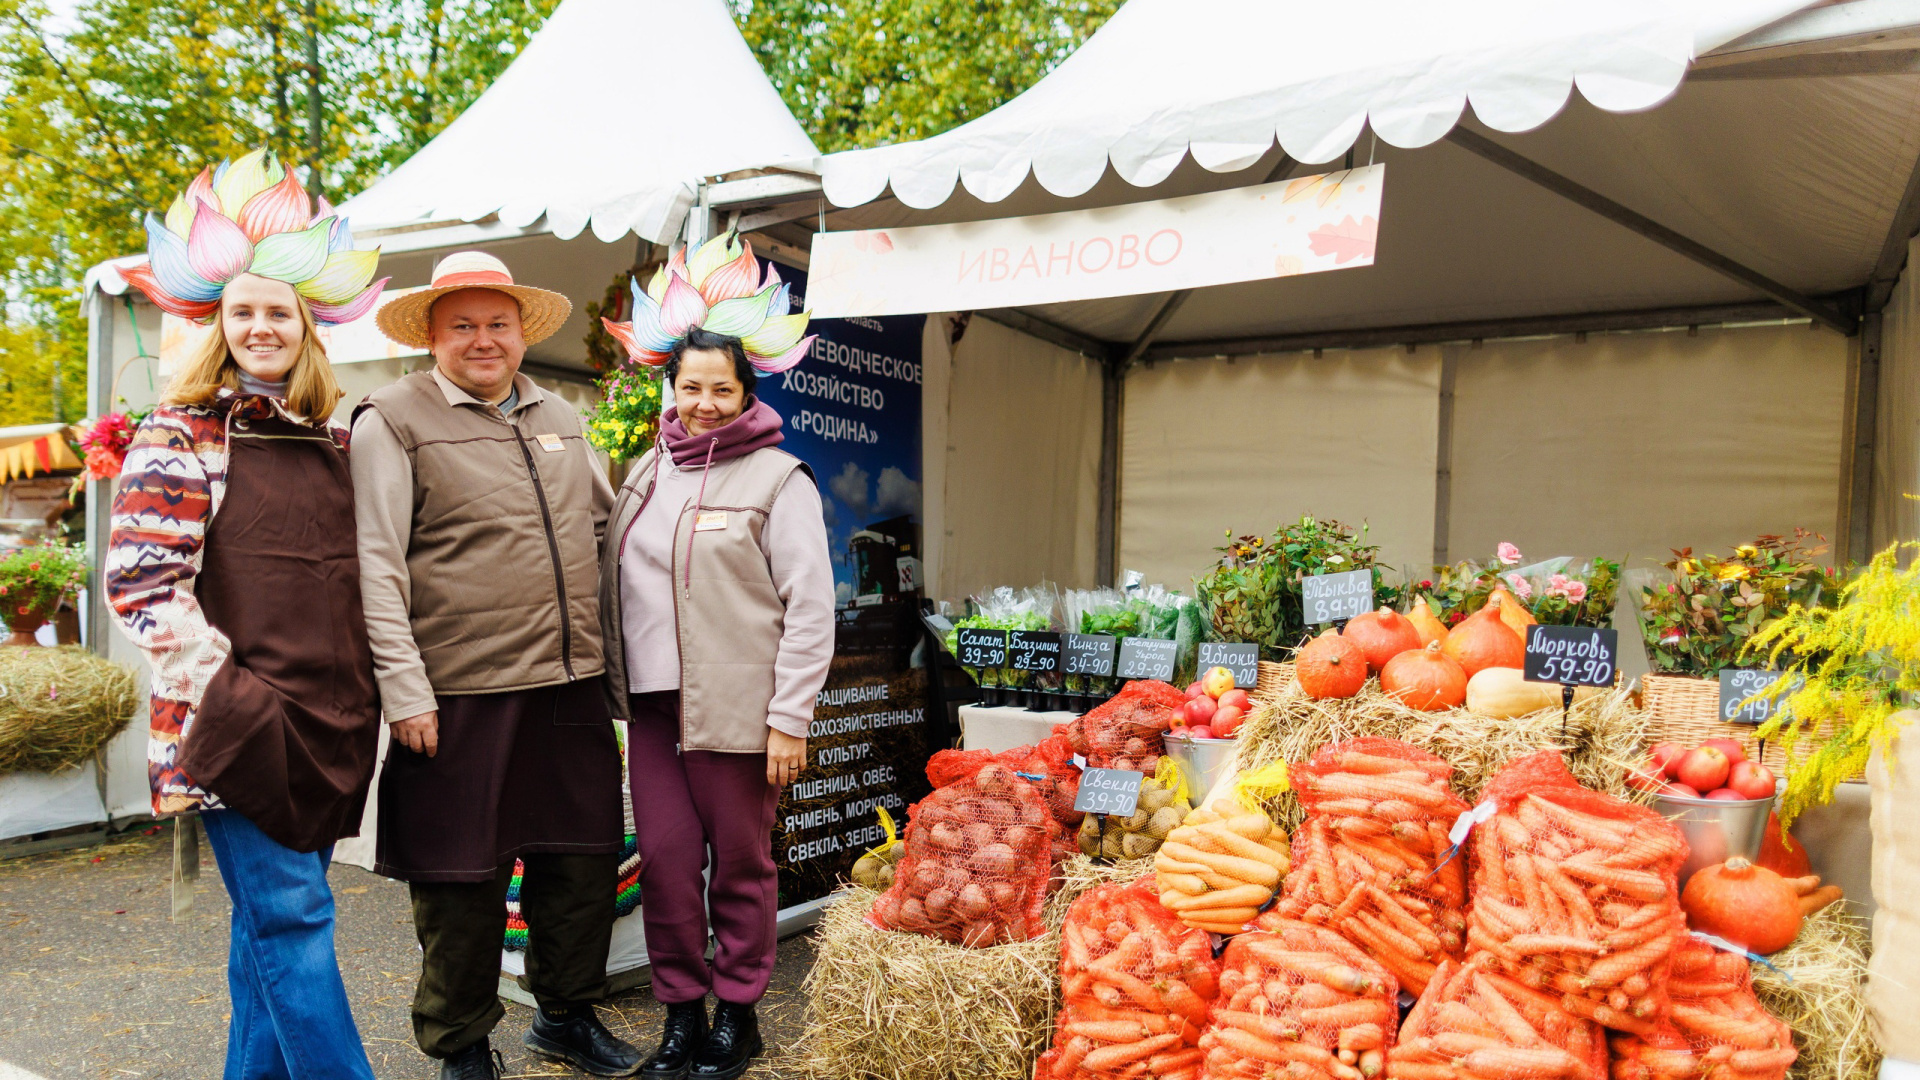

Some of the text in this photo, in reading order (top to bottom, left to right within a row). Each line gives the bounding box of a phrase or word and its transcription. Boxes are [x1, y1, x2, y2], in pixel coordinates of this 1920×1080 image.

[957, 228, 1183, 284] ИВАНОВО
[781, 368, 885, 410] ХОЗЯЙСТВО
[790, 409, 879, 444] «РОДИНА»
[1304, 573, 1369, 600] Тыква
[1314, 595, 1370, 622] 89-90
[959, 628, 1006, 648] Салат
[1009, 631, 1060, 658] Базилик
[1067, 633, 1111, 658] Кинза
[1526, 626, 1610, 660] Морковь
[962, 647, 1005, 665] 39-90
[1013, 655, 1056, 671] 29-90
[1065, 656, 1110, 674] 34-90
[1134, 649, 1168, 662] Укроп
[1199, 643, 1257, 667] Яблоки
[1123, 660, 1170, 678] 29-90
[1536, 656, 1612, 685] 59-90
[818, 742, 874, 767] КУЛЬТУР:
[792, 764, 897, 801] ПШЕНИЦА, ОВЁС,
[1083, 768, 1138, 793] Свекла
[784, 792, 905, 834] ЯЧМЕНЬ, МОРКОВЬ,
[1082, 791, 1134, 813] 39-90
[787, 835, 844, 863] СВЕКЛА,
